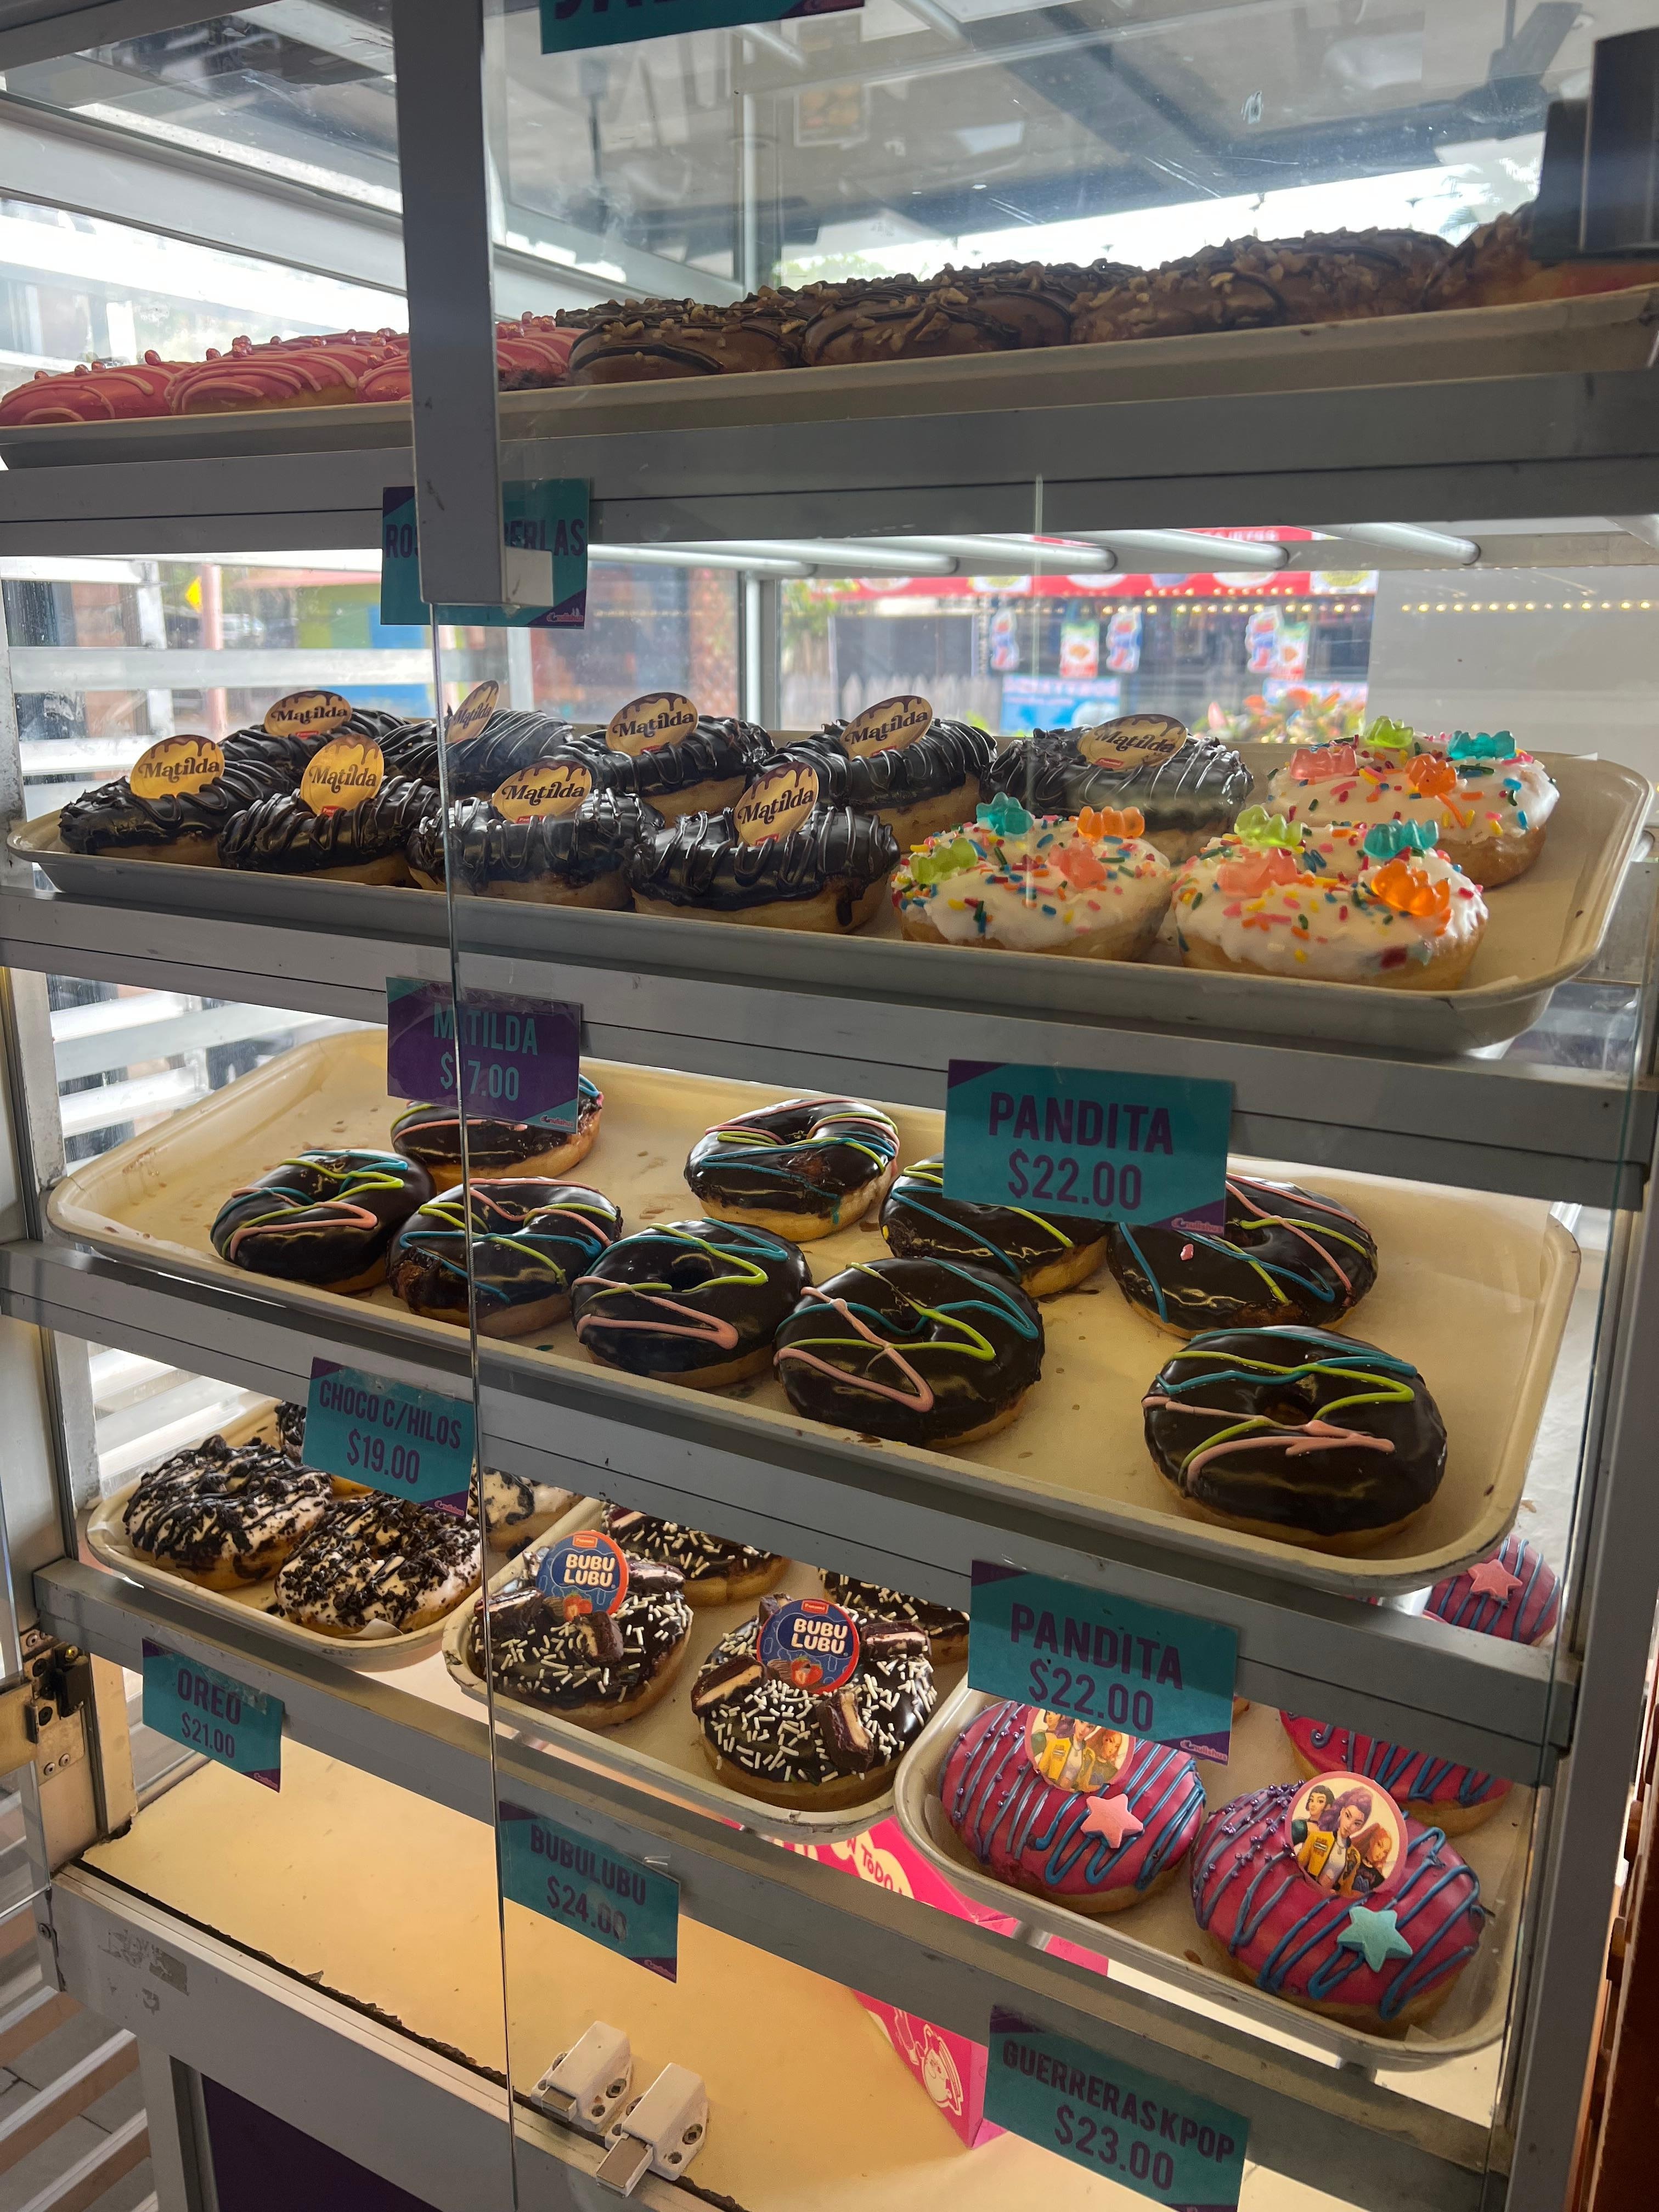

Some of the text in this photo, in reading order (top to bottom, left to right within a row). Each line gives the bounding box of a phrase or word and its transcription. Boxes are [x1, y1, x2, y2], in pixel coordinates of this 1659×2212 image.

[271, 706, 347, 724] Matilda
[452, 703, 492, 729] Matilda
[612, 712, 695, 737] Matilda
[845, 711, 928, 741] Matilda
[1094, 729, 1175, 752] Matilda
[138, 757, 219, 783] Matilda
[308, 768, 376, 793] Matilda
[501, 782, 584, 806] Matilda
[737, 788, 814, 825] Matilda
[433, 1002, 538, 1056] MTILDA
[440, 1052, 519, 1101] $7.00
[989, 1091, 1173, 1155] PANDITA
[1008, 1149, 1142, 1210] $22.00
[319, 1380, 462, 1449] CHOCO C/HILOS
[347, 1429, 420, 1484] $19.00
[563, 1569, 613, 1587] LUBU
[566, 1554, 616, 1572] BUBU
[791, 1633, 845, 1654] LUBU
[794, 1618, 848, 1639] BUBU
[1011, 1602, 1182, 1690] PANDITA
[178, 1668, 241, 1725] OREO
[1028, 1658, 1153, 1731] $22.00
[182, 1712, 235, 1758] $21.00
[531, 1824, 646, 1905] BUBULUBU
[547, 1875, 627, 1942] $24.00
[1003, 2040, 1235, 2163] GUERRERASKPOP
[1054, 2105, 1173, 2190] $23.00
